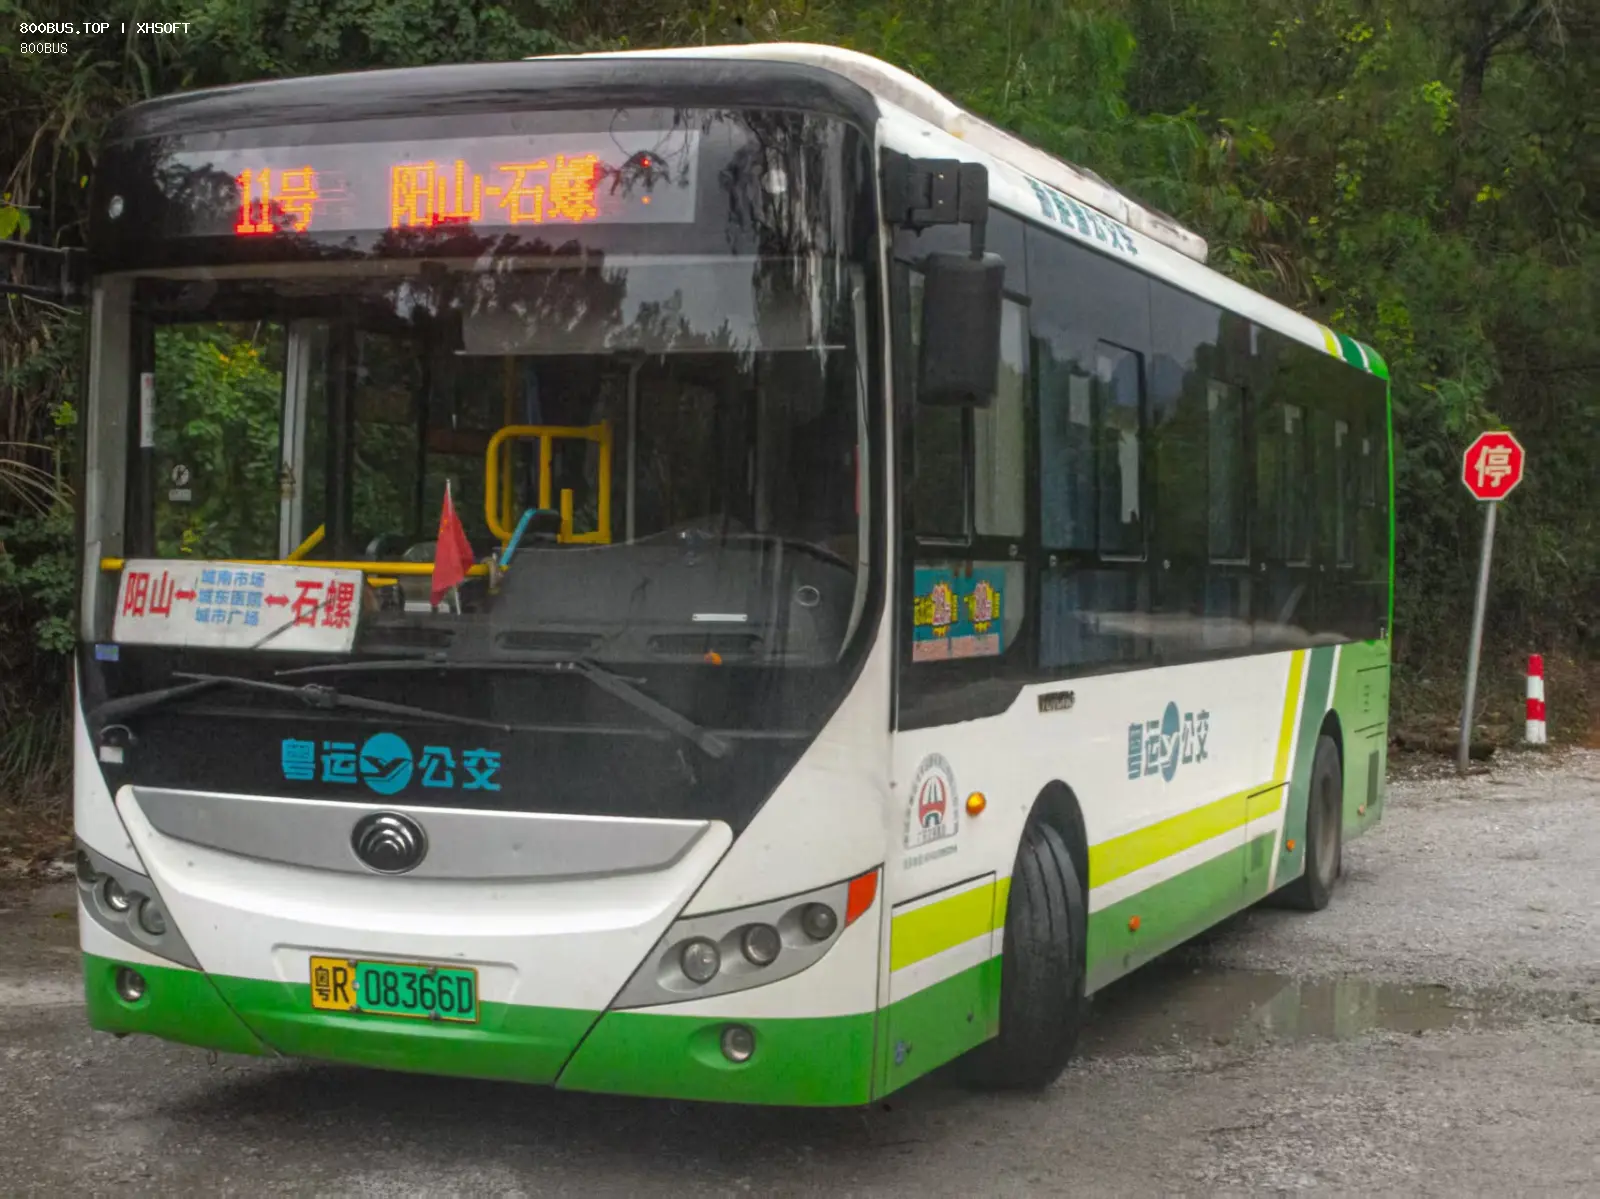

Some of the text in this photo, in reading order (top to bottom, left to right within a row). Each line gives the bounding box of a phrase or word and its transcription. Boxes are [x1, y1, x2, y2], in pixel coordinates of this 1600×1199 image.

[234, 165, 319, 234] 11号
[1474, 444, 1512, 488] 停
[123, 570, 175, 618] 阳山
[291, 579, 356, 629] 石螺
[1181, 708, 1210, 764] 公交
[281, 738, 502, 791] 粤运 公交
